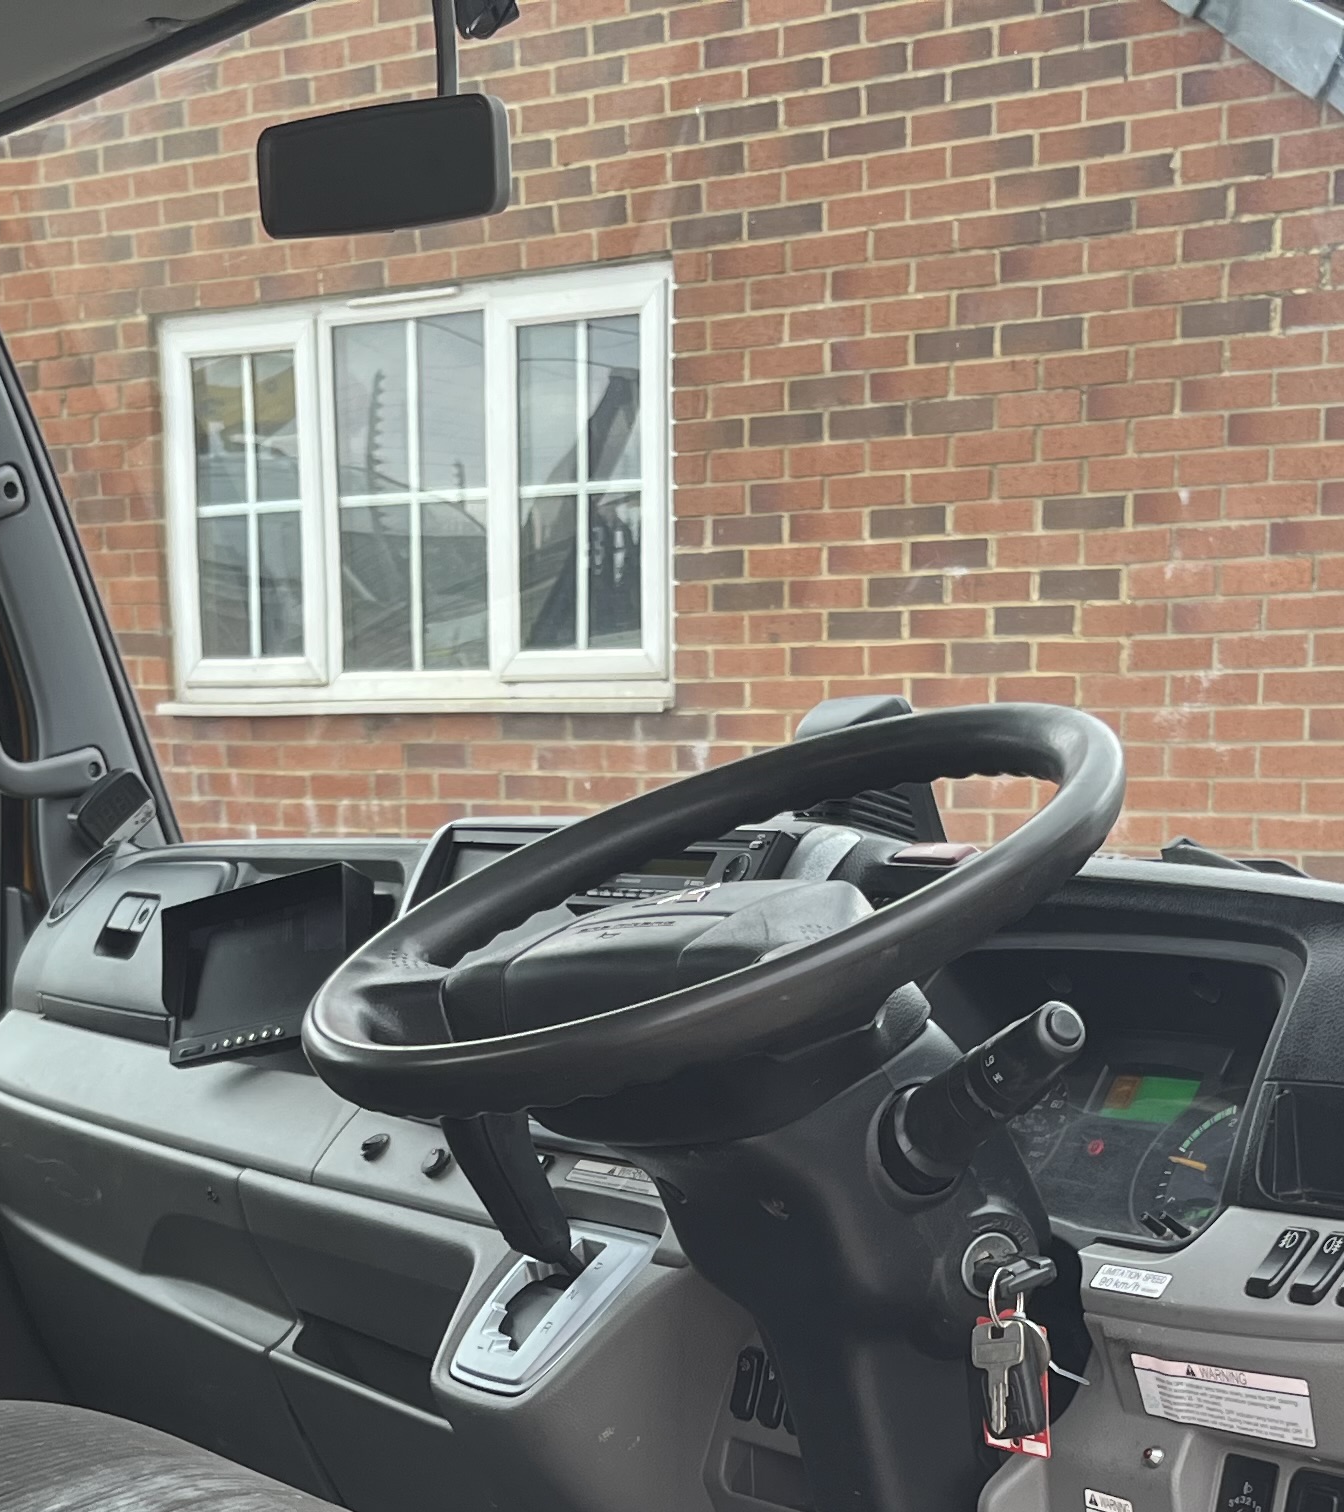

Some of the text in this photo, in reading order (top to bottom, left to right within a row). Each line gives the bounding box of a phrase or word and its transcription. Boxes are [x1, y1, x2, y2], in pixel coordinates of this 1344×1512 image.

[1101, 1266, 1168, 1285] LIMITATION SPEED
[1113, 1278, 1141, 1292] km/h
[1199, 1366, 1248, 1386] WARNING
